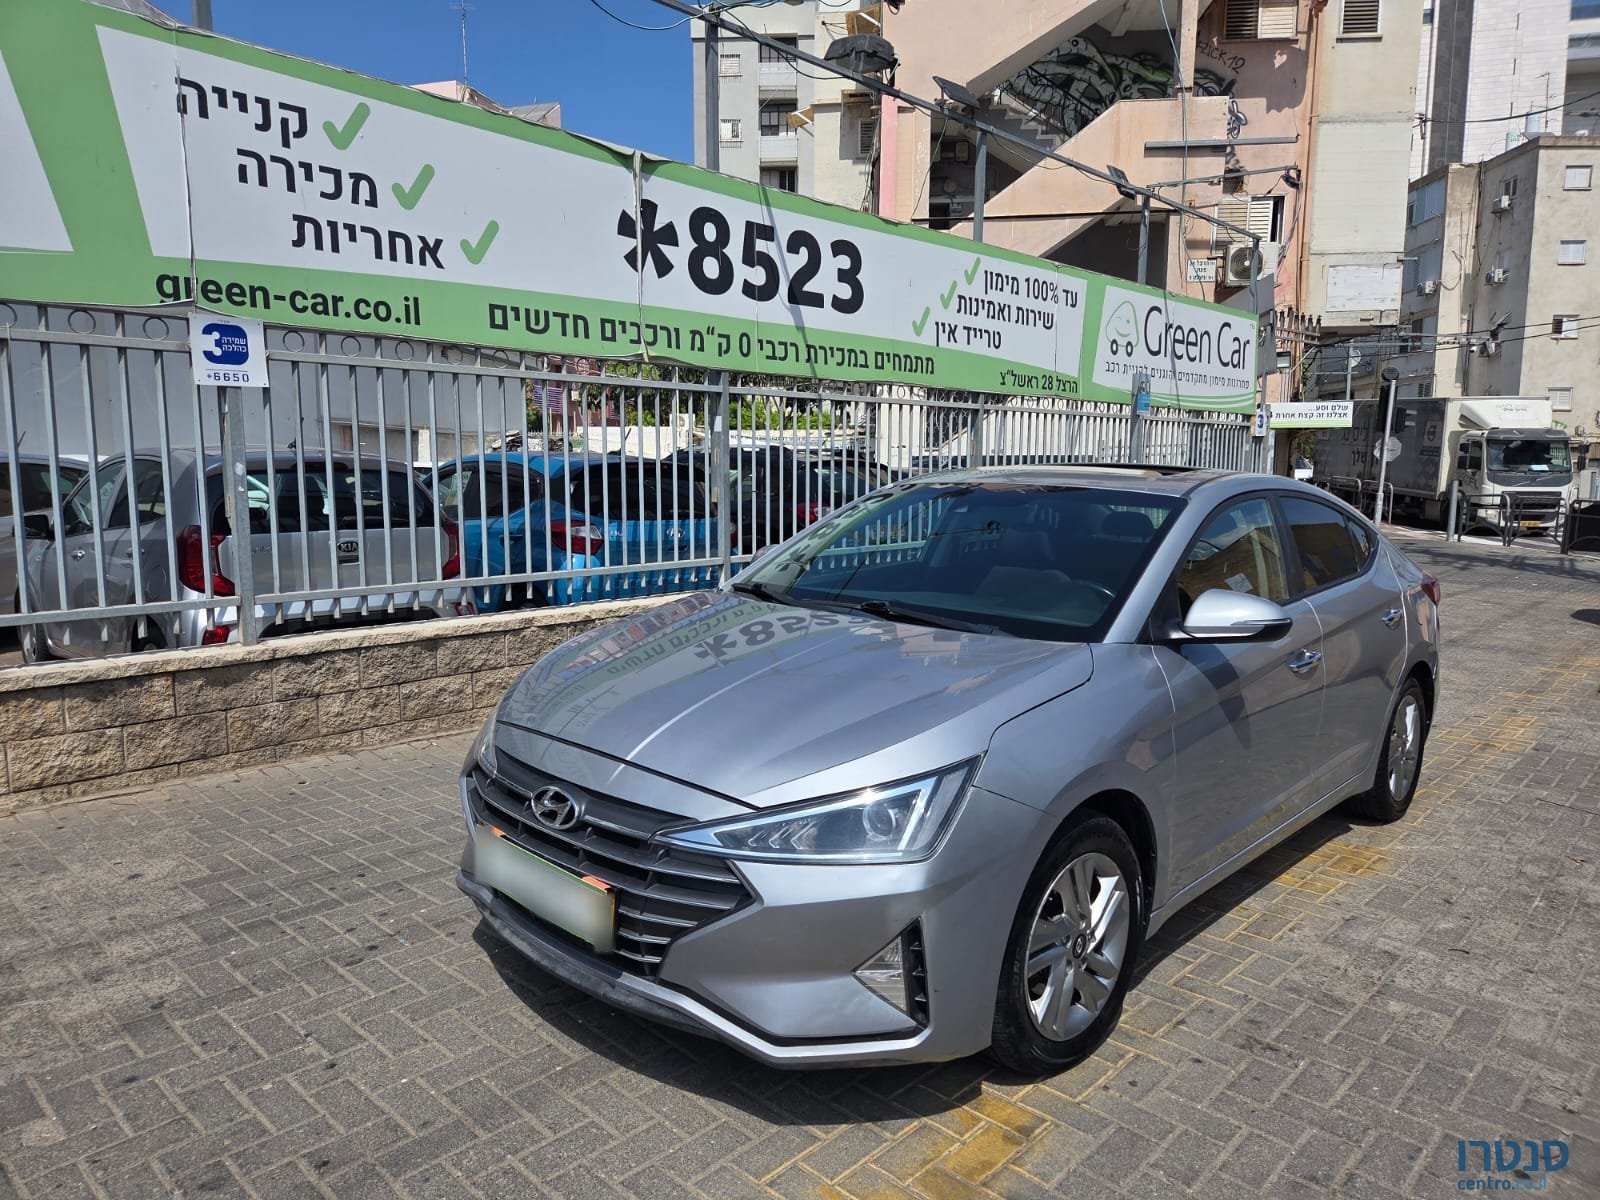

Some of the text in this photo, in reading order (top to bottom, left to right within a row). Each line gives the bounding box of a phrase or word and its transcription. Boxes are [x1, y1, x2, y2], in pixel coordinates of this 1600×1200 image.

[175, 76, 308, 149] קנייה
[236, 147, 379, 208] מכירה
[291, 213, 446, 269] אחריות
[155, 272, 421, 326] green-car.co.il
[984, 269, 1078, 309] עד 100% מימון
[488, 303, 590, 340] חדשים
[956, 294, 1054, 330] שירות ואמינות
[221, 336, 246, 345] שמירה
[600, 317, 681, 350] ורכבים
[757, 337, 800, 363] רכבי
[934, 321, 1002, 349] טרייד אין
[1144, 305, 1251, 370] Green Car
[805, 342, 870, 369] במכירת
[874, 350, 935, 375] מתמחים
[1041, 374, 1054, 391] 28
[1055, 375, 1078, 394] הרצל
[339, 542, 358, 552] KIA
